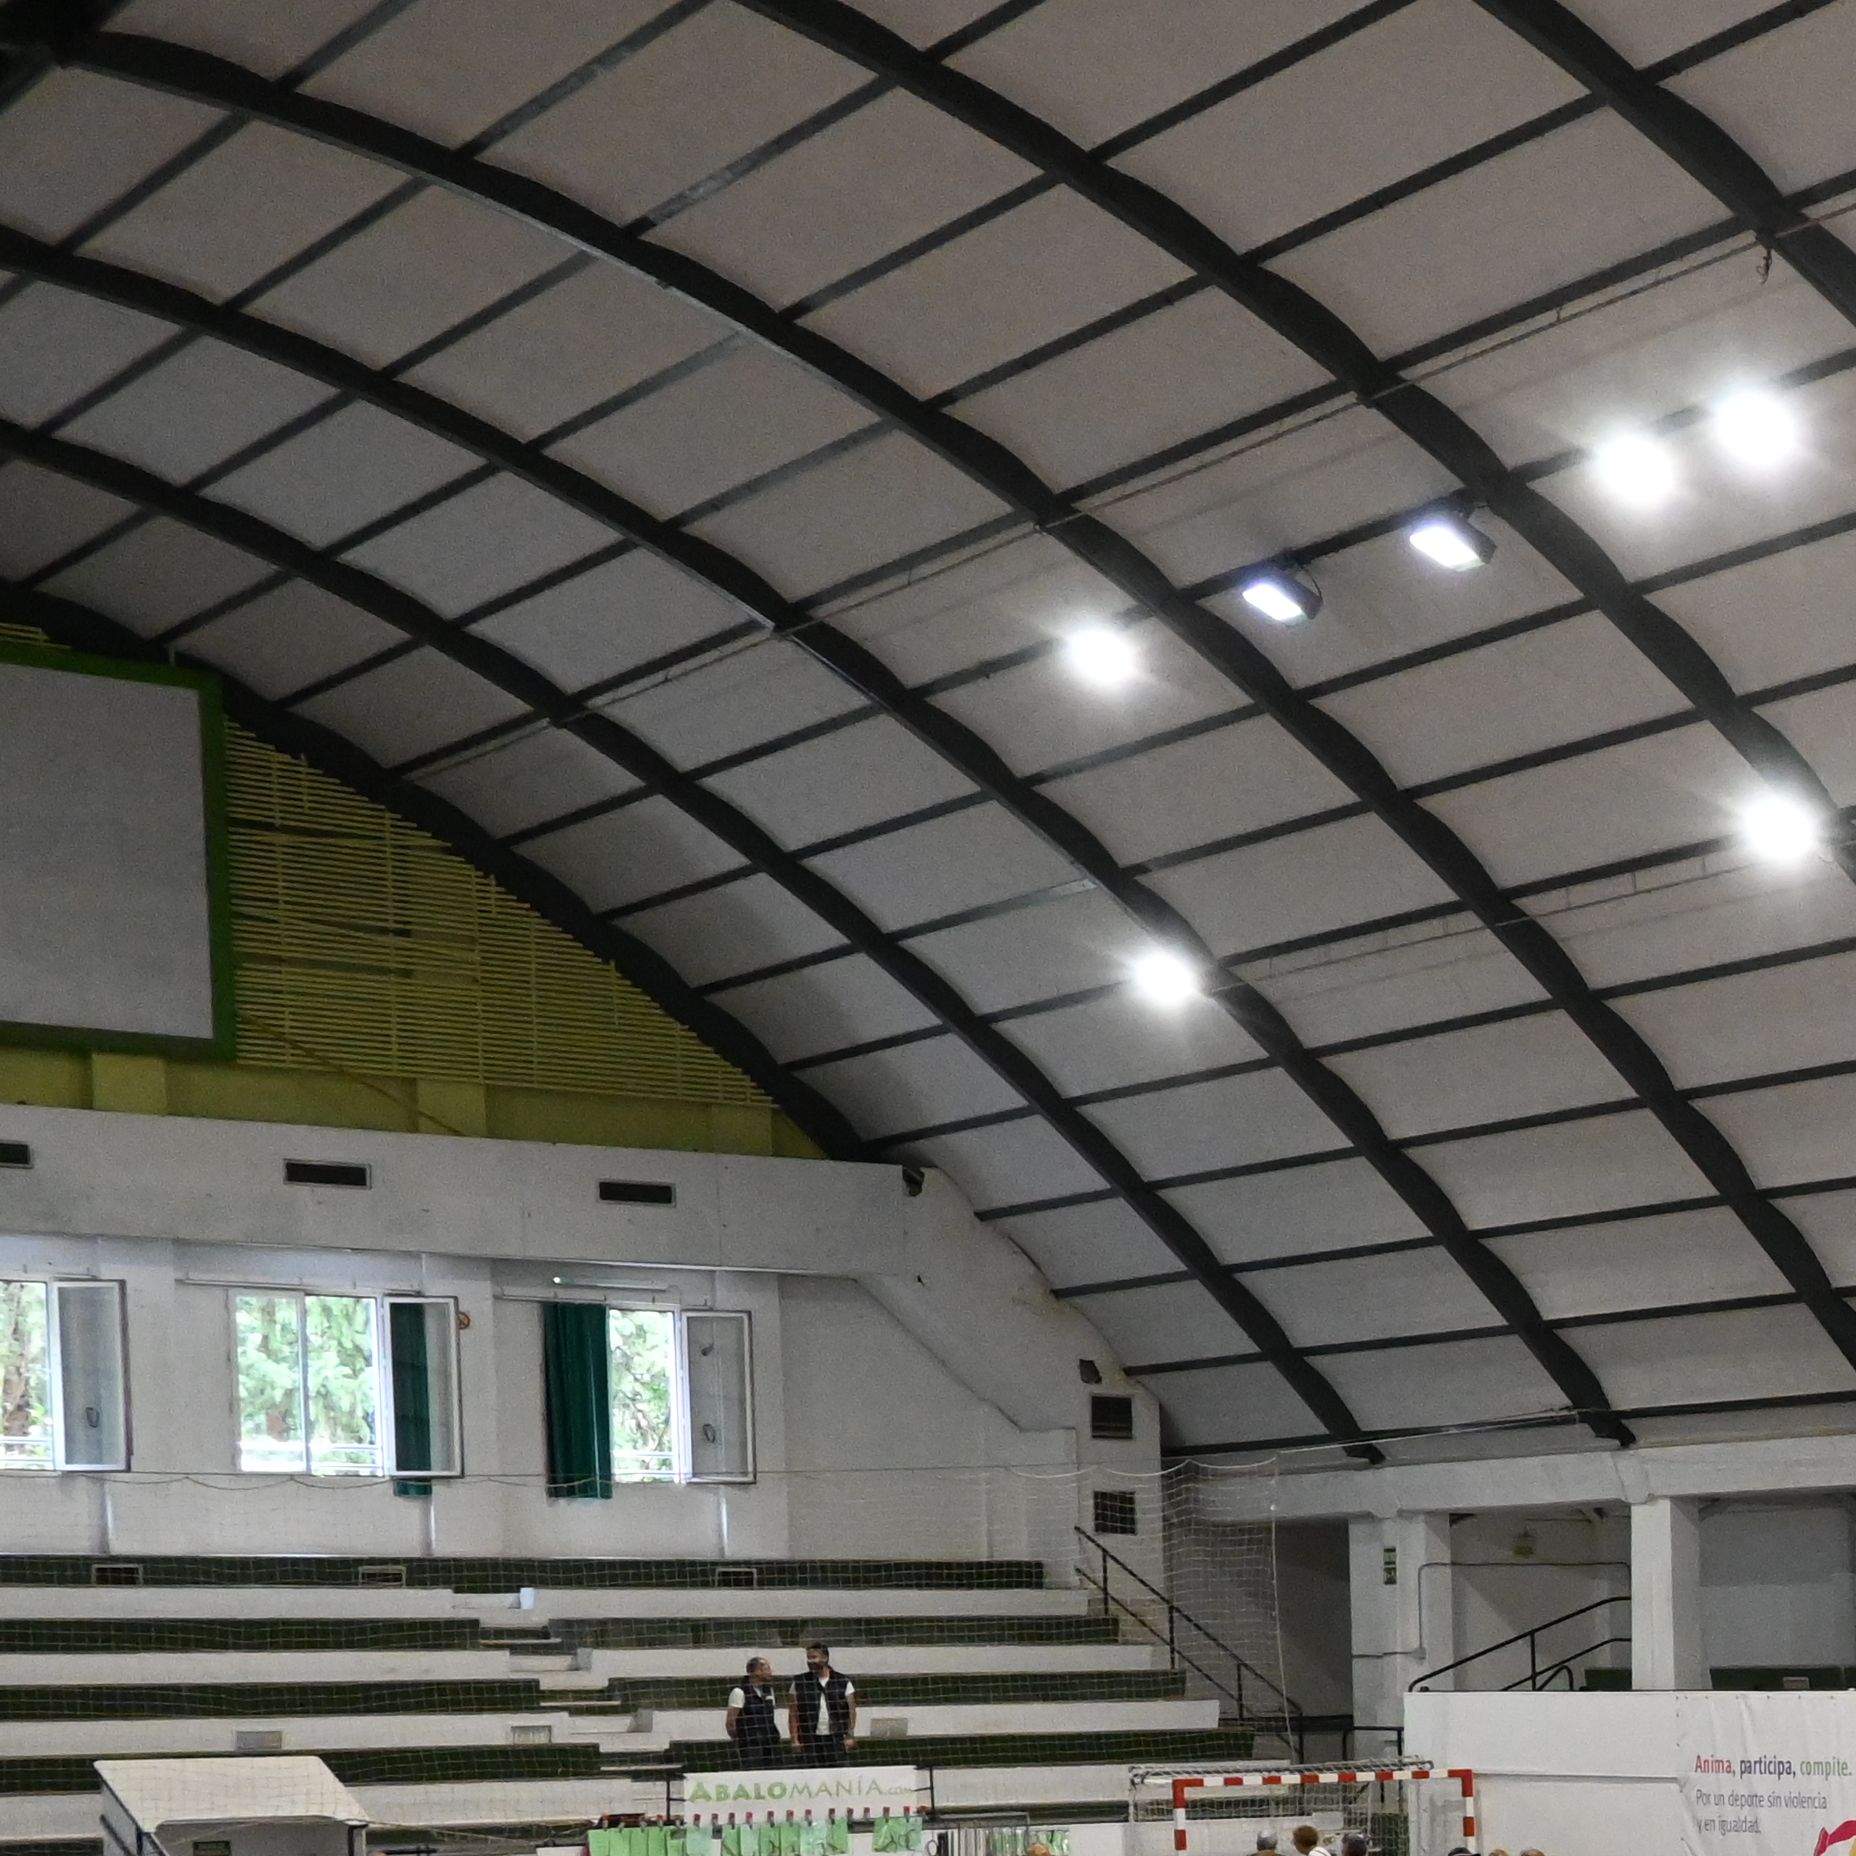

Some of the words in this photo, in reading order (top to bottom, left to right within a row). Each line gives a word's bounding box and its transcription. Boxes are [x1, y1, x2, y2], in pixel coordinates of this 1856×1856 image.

[1695, 1754, 1736, 1777] Anima,
[1739, 1757, 1796, 1781] participa,
[1799, 1758, 1853, 1778] compite.
[1696, 1789, 1711, 1807] Por
[1713, 1793, 1725, 1807] un
[1728, 1791, 1765, 1810] deporte
[1767, 1791, 1782, 1808] sin
[1784, 1792, 1827, 1809] violencia
[1703, 1819, 1716, 1832] en
